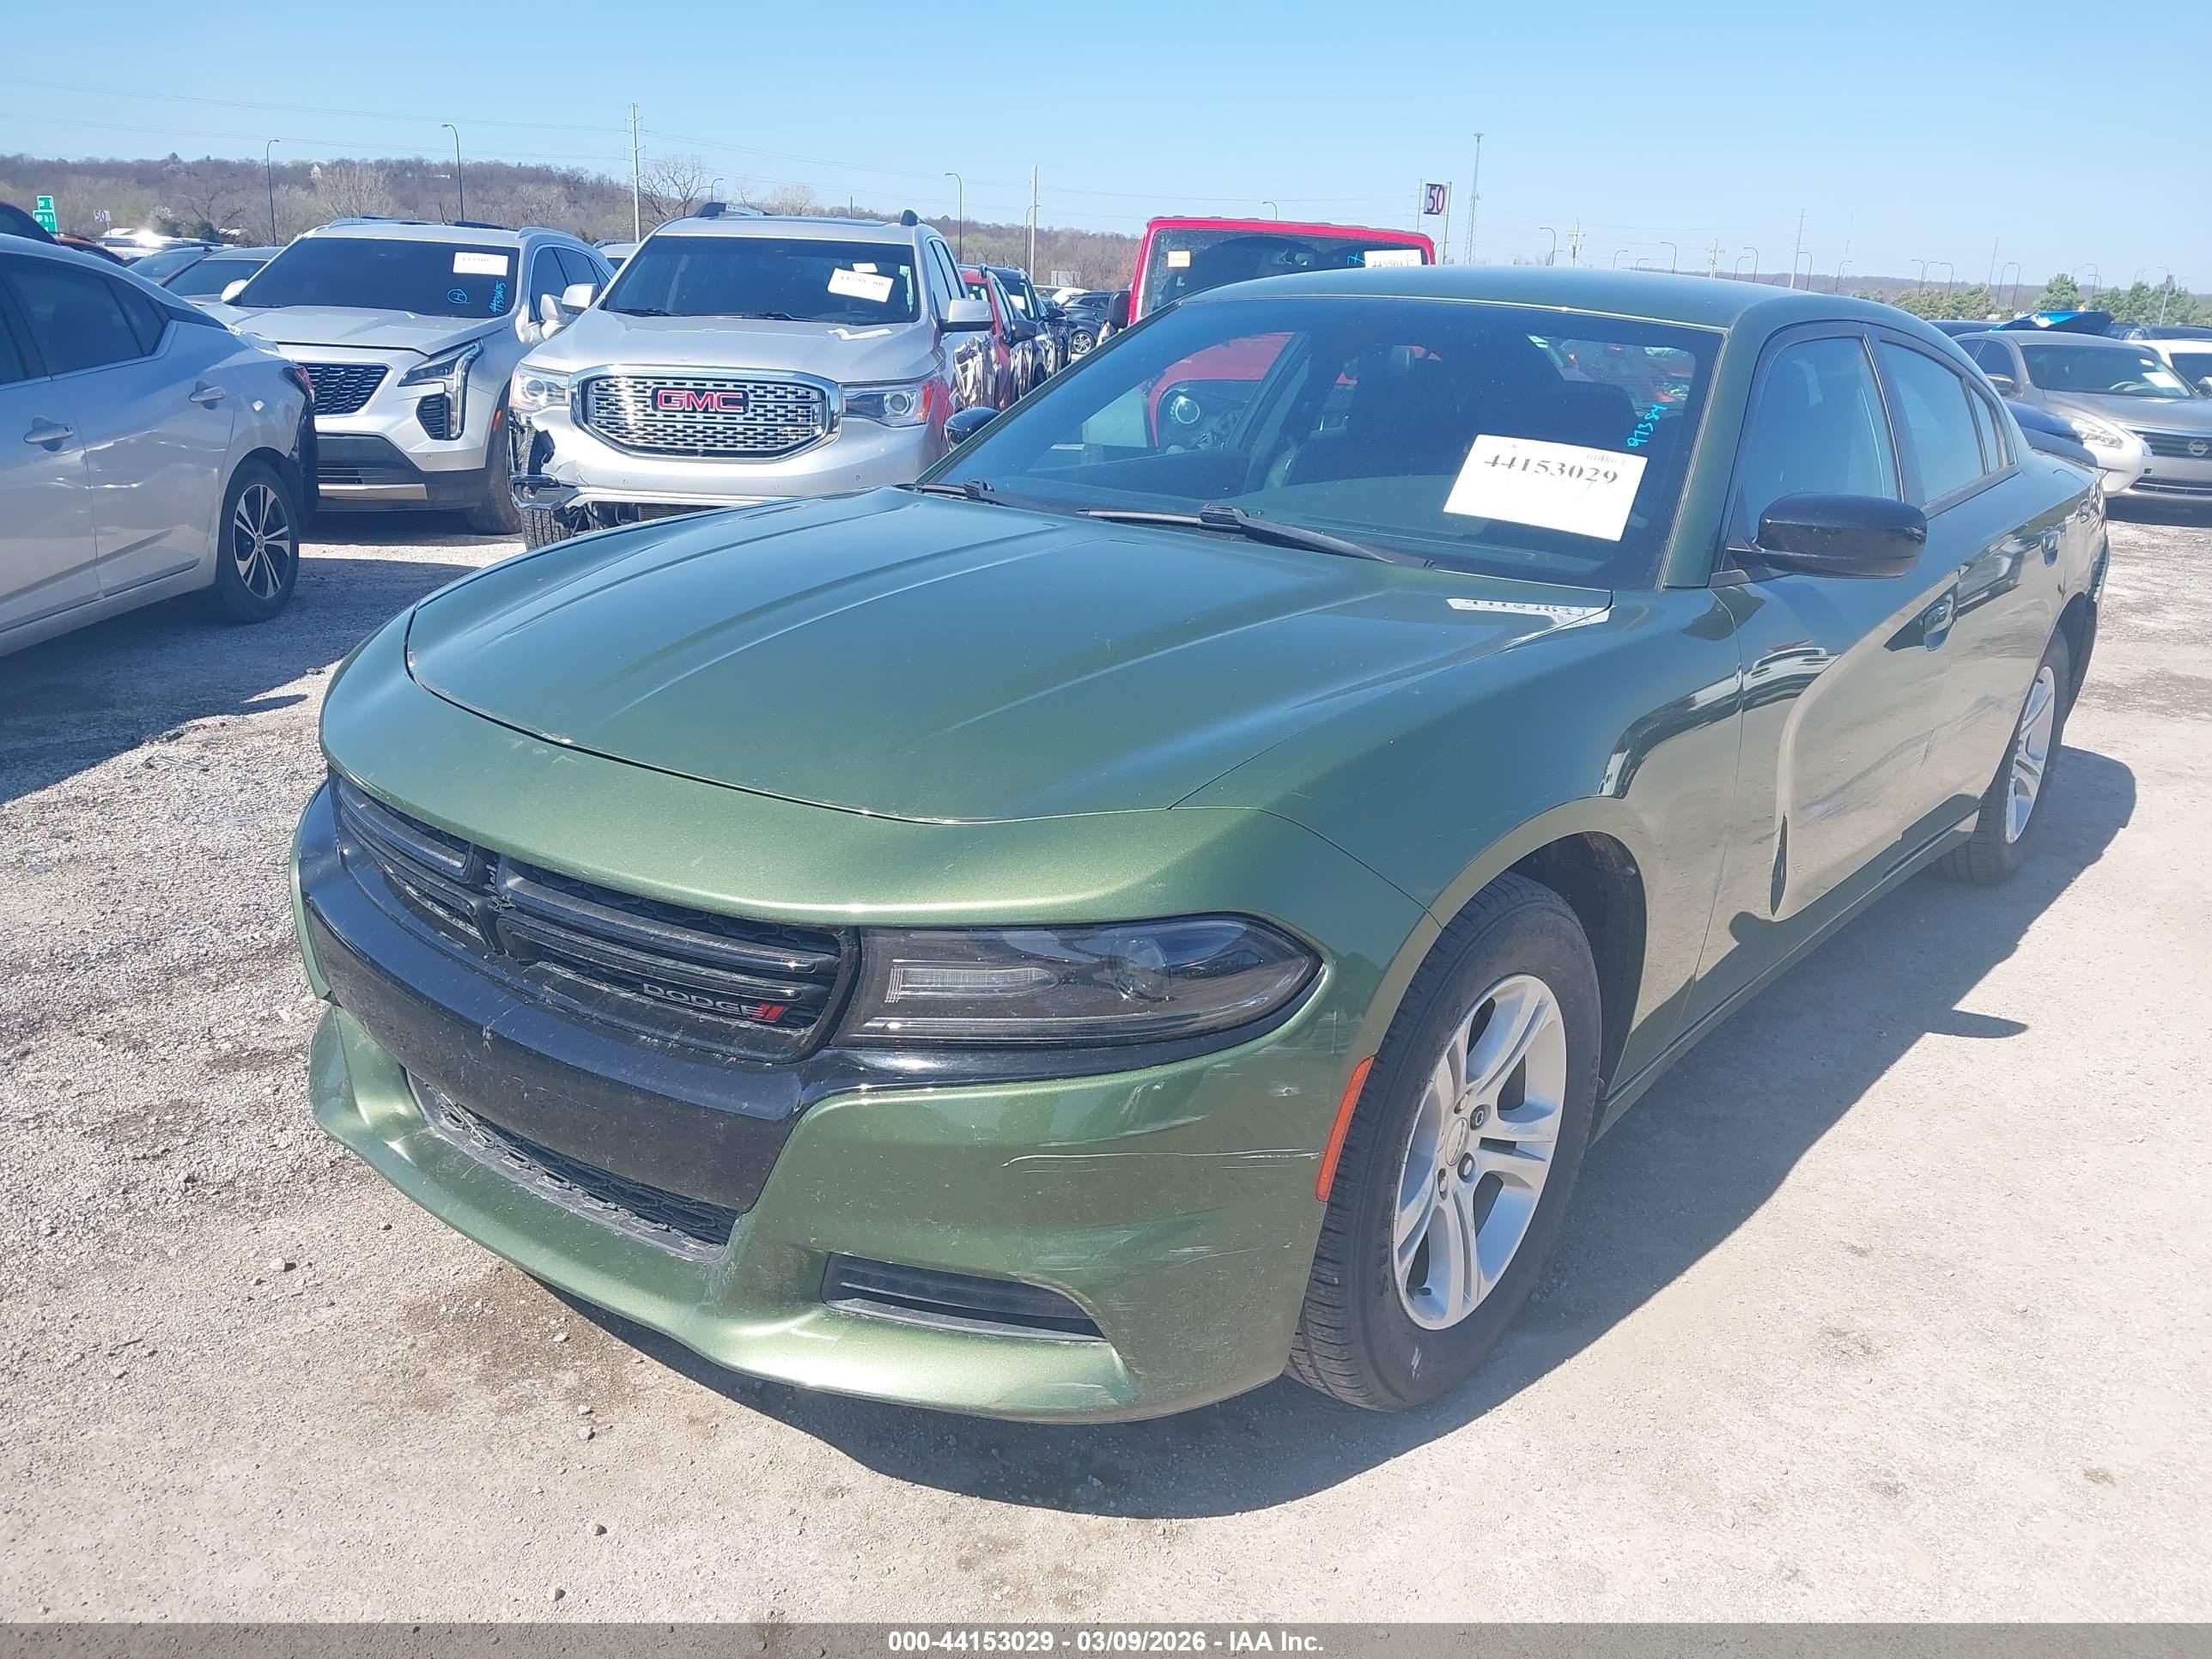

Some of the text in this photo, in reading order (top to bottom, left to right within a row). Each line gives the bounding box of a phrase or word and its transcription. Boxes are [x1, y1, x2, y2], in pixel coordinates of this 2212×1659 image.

[1427, 184, 1445, 214] 50
[658, 389, 744, 412] GMC
[1484, 453, 1619, 483] 44153029
[642, 982, 764, 1018] DODGE
